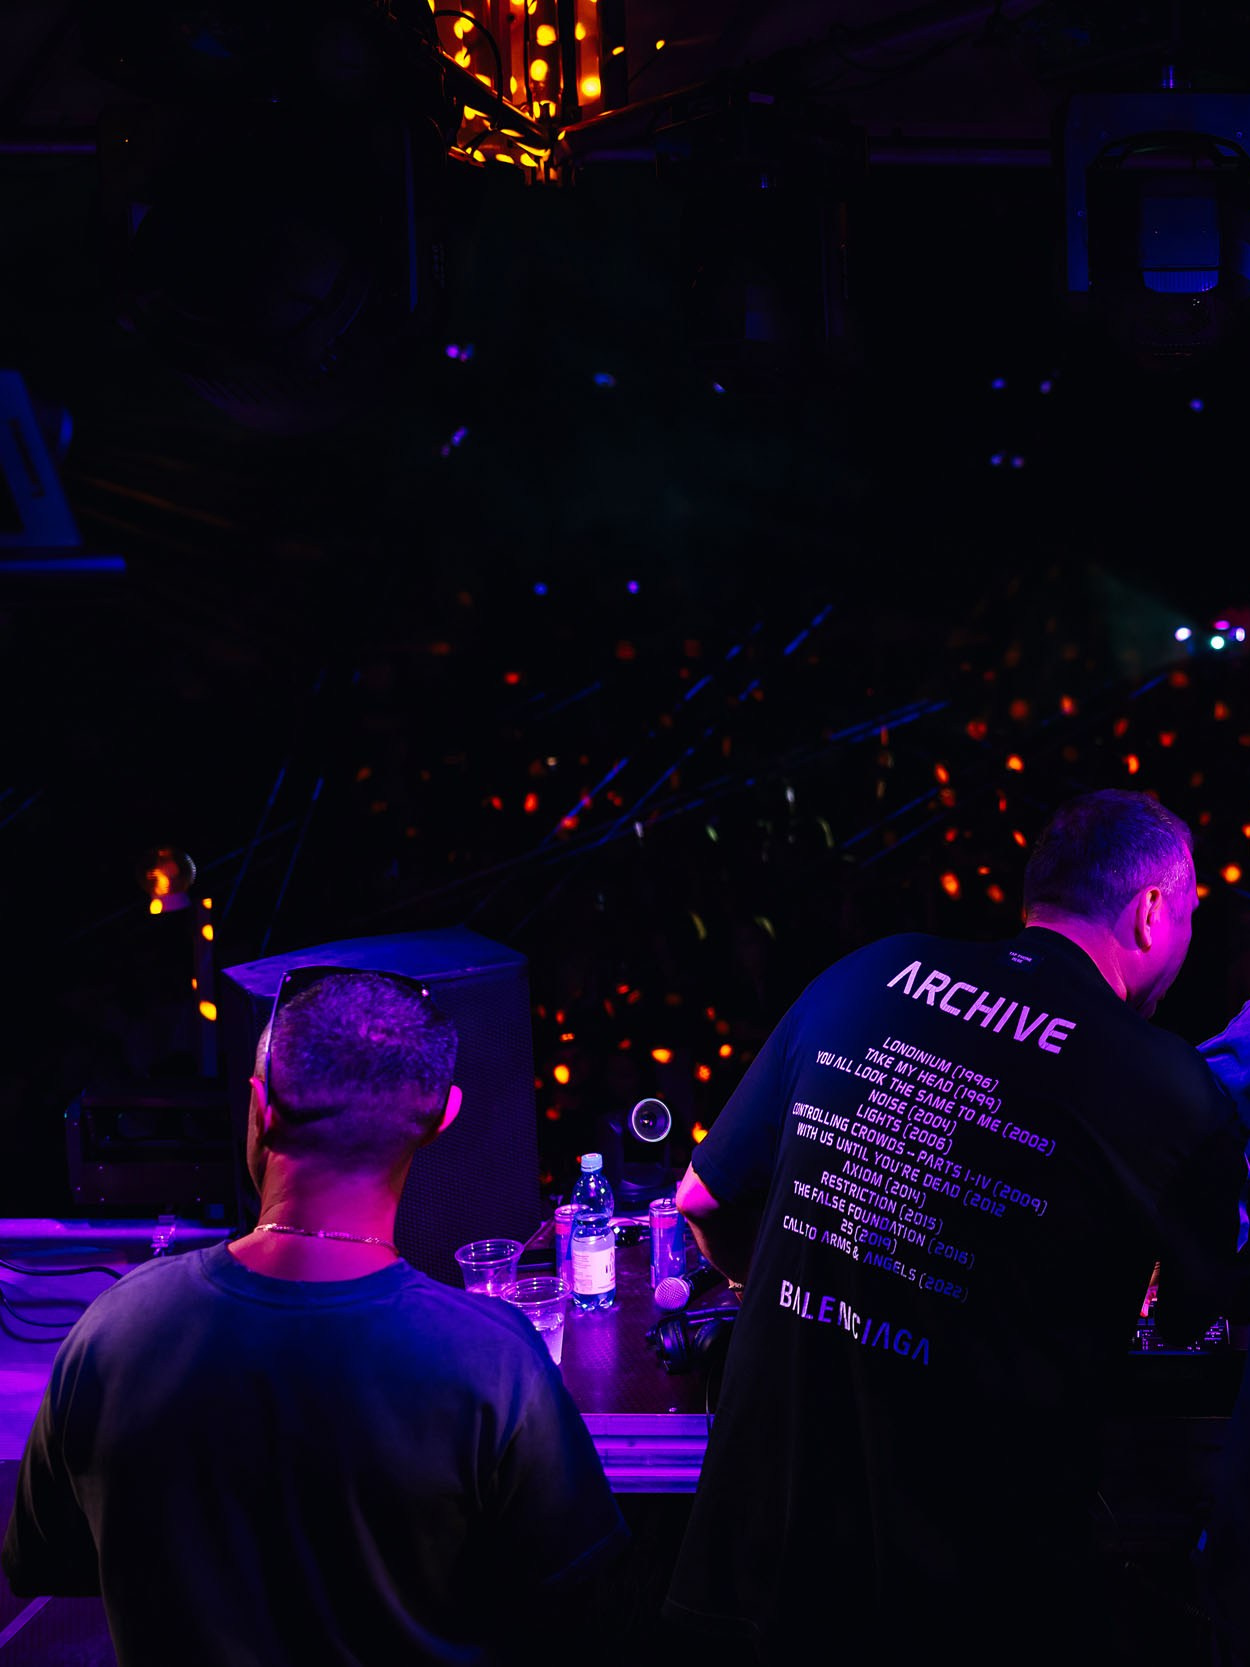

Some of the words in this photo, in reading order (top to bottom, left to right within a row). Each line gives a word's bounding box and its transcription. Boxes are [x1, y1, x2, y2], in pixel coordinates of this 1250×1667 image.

[886, 960, 1077, 1054] ARCHIVE
[864, 1047, 895, 1069] TAKE
[894, 1060, 918, 1077] MY
[917, 1069, 954, 1093] HEAD
[953, 1084, 1002, 1115] (1999)
[882, 1036, 952, 1073] LONDINIUM
[951, 1064, 1000, 1093] (1996)
[815, 1050, 835, 1066] YOU
[832, 1056, 853, 1073] ALL
[853, 1063, 888, 1086] LOOK
[889, 1077, 915, 1097] THE
[915, 1089, 956, 1114] SAME
[957, 1104, 976, 1122] TO
[976, 1113, 1002, 1132] ME
[1002, 1121, 1057, 1157] (2002)
[856, 1103, 902, 1133] LIGHTS
[902, 1122, 953, 1156] (2006)
[867, 1088, 908, 1115] NOISE
[907, 1104, 957, 1137] (2004)
[796, 1121, 818, 1141] WITH
[819, 1129, 835, 1147] US
[835, 1136, 869, 1162] UNTIL
[874, 1151, 920, 1183] YOU'RE
[922, 1173, 961, 1199] DEAD
[841, 1159, 883, 1188] AXIOM
[884, 1176, 928, 1209] (2014)
[850, 1122, 906, 1155] CROWDS
[916, 1150, 963, 1179] PARTS
[963, 1168, 992, 1190] I-IV
[992, 1180, 1048, 1217] (2009)
[793, 1180, 811, 1199] THE
[811, 1187, 846, 1213] FALSE
[847, 1206, 926, 1247] FOUNDATION
[820, 1170, 897, 1214] RESTRICTION
[898, 1203, 944, 1236] (2015)
[840, 1218, 854, 1236] 25
[820, 1229, 852, 1254] ARMS
[852, 1245, 860, 1261] &
[862, 1250, 917, 1282] ANGELS
[917, 1272, 969, 1304] (2022)
[779, 1279, 930, 1366] BALENCIAGA
